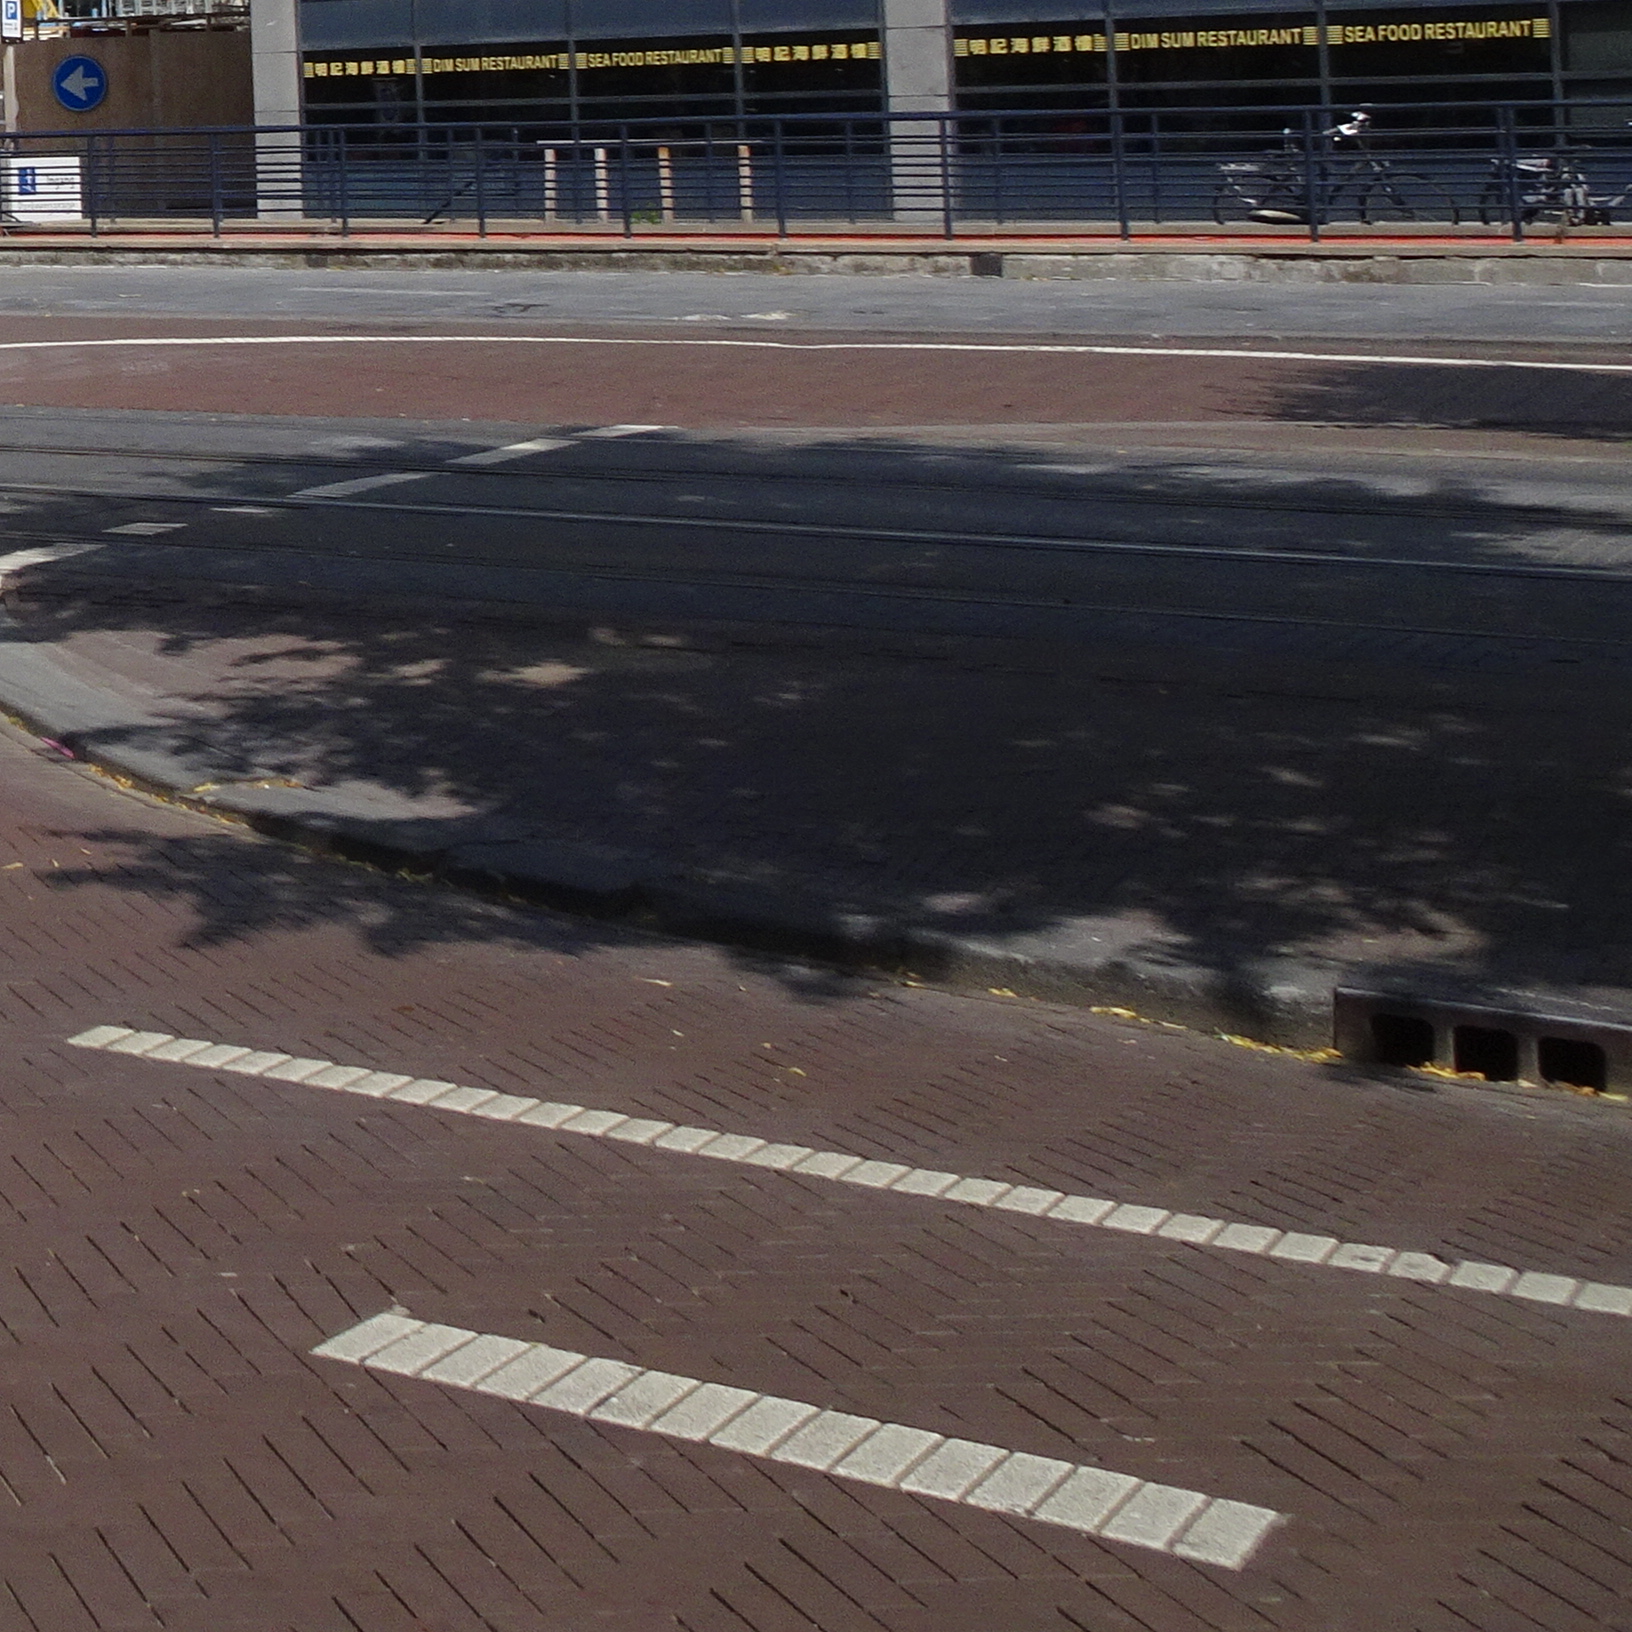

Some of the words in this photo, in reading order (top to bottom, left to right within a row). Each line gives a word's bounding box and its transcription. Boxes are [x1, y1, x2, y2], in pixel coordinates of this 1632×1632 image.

[1131, 33, 1159, 49] DIM
[1161, 32, 1194, 48] SUM
[1197, 28, 1301, 47] RESTAURANT
[1345, 25, 1376, 42] SEA
[1378, 24, 1422, 42] FOOD
[1424, 20, 1531, 40] RESTAURANT
[433, 57, 454, 72] DIM
[455, 57, 480, 72] SUM
[481, 54, 559, 71] RESTAURANT
[589, 53, 612, 67] SEA
[612, 52, 644, 66] FOOD
[645, 48, 724, 65] RESTAURANT
